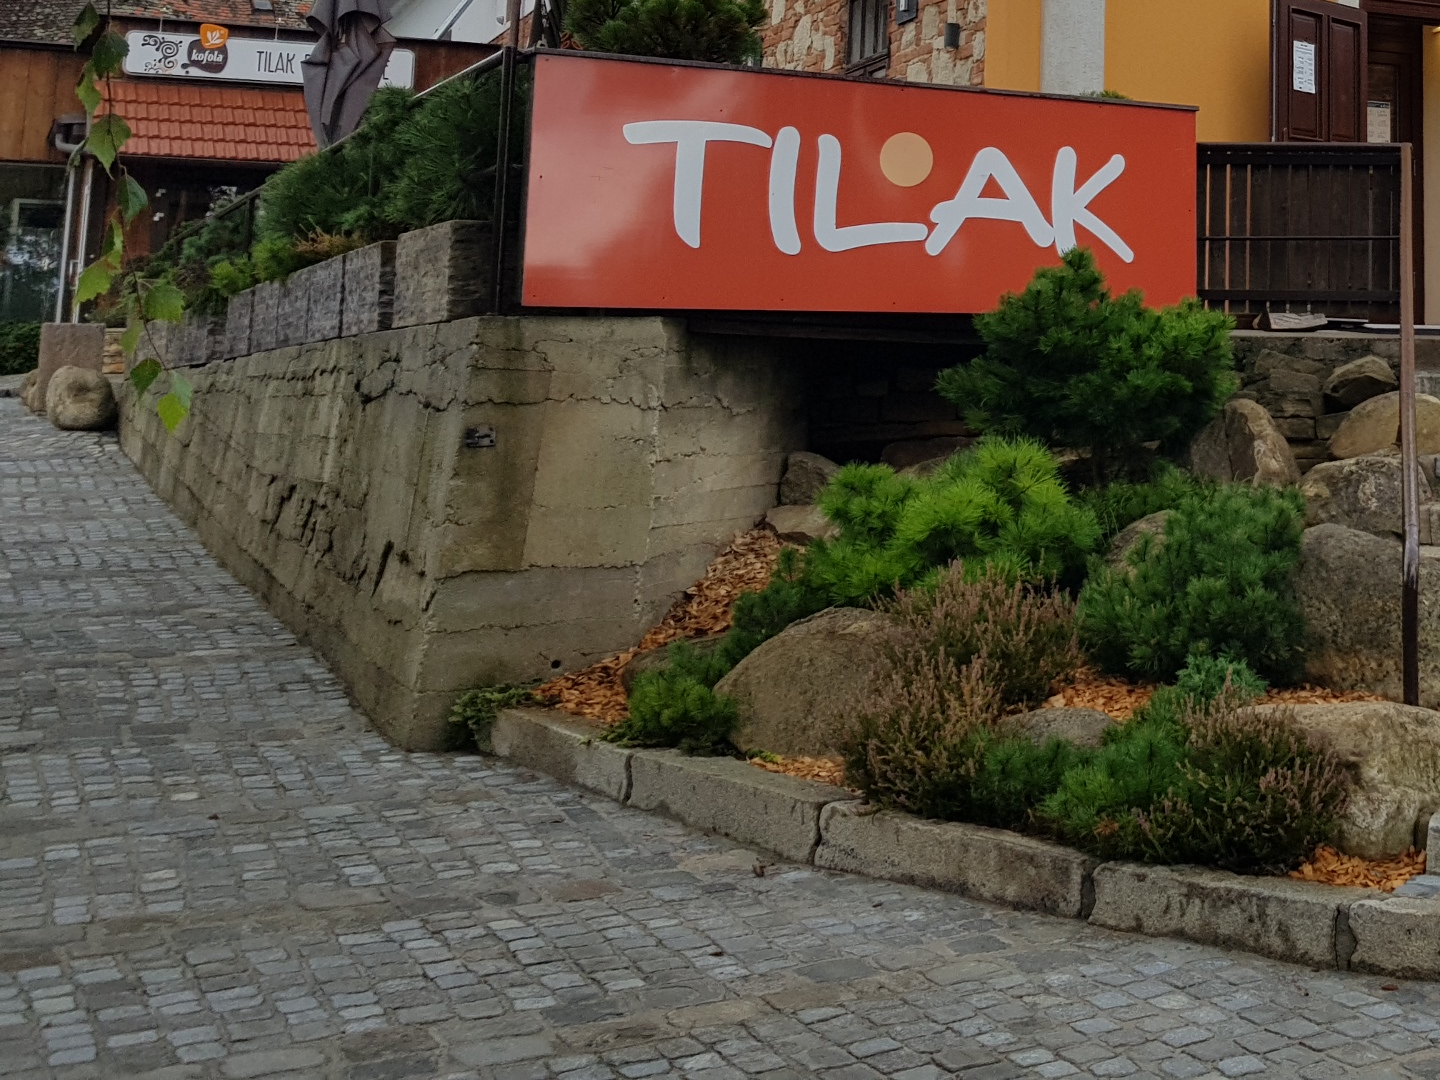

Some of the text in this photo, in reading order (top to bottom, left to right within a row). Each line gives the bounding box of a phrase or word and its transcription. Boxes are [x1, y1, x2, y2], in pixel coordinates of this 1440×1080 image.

[191, 50, 224, 65] kofola
[256, 50, 296, 75] TILAK
[622, 120, 1135, 264] TILAK
